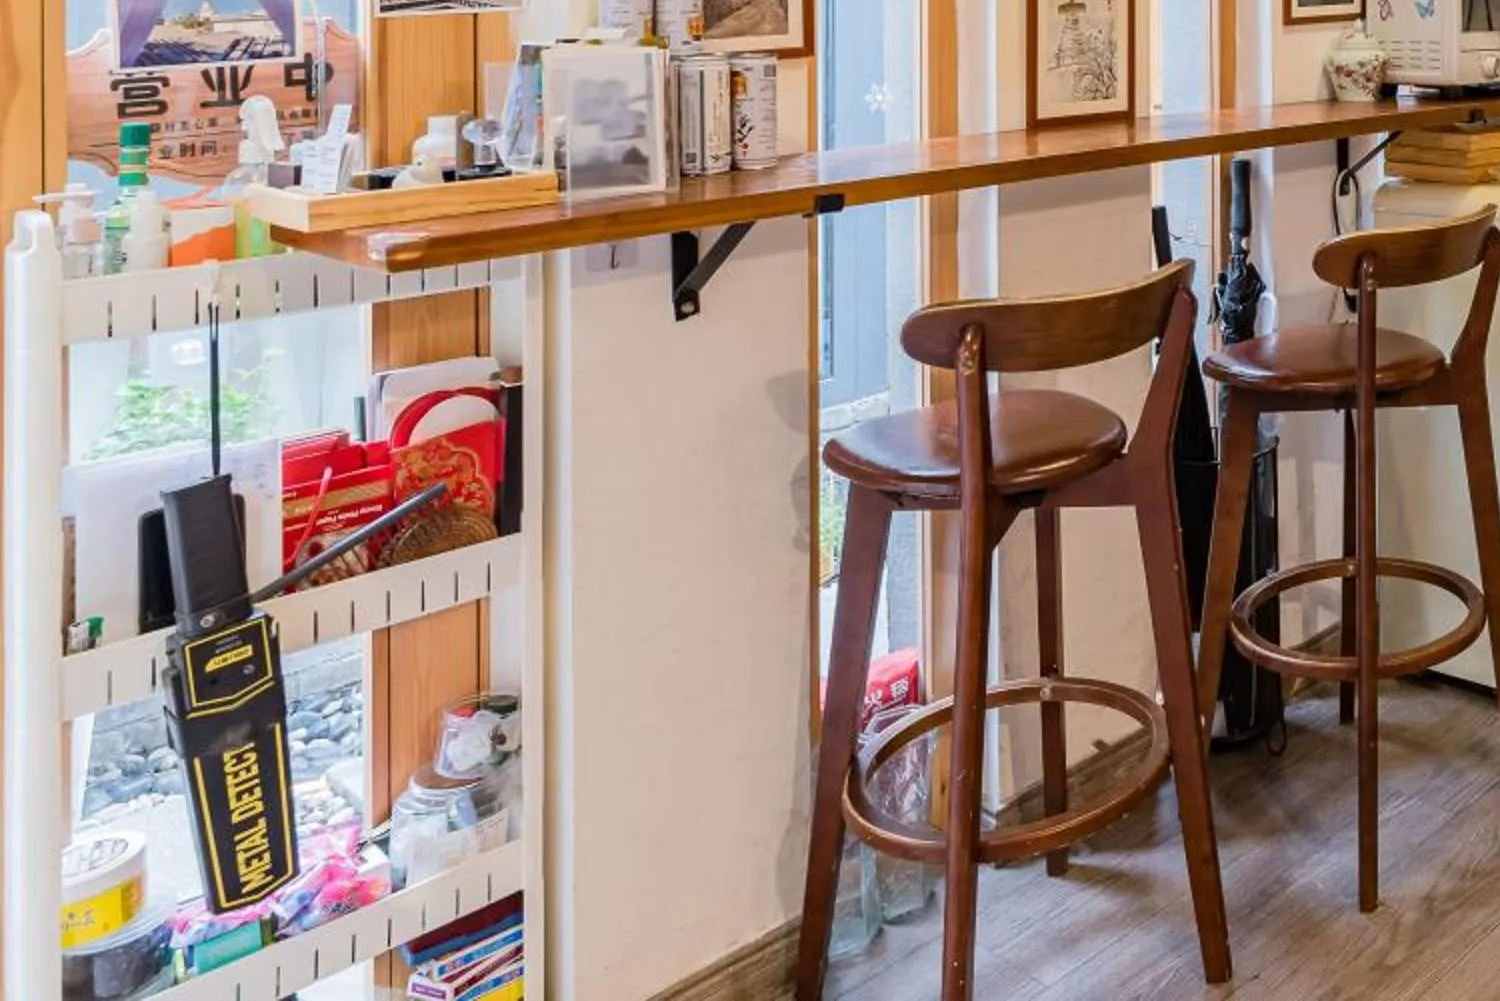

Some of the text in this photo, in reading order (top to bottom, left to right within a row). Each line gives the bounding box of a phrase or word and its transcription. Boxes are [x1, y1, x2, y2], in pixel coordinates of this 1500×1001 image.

[109, 52, 335, 120] 营业中
[233, 816, 275, 895] METAL
